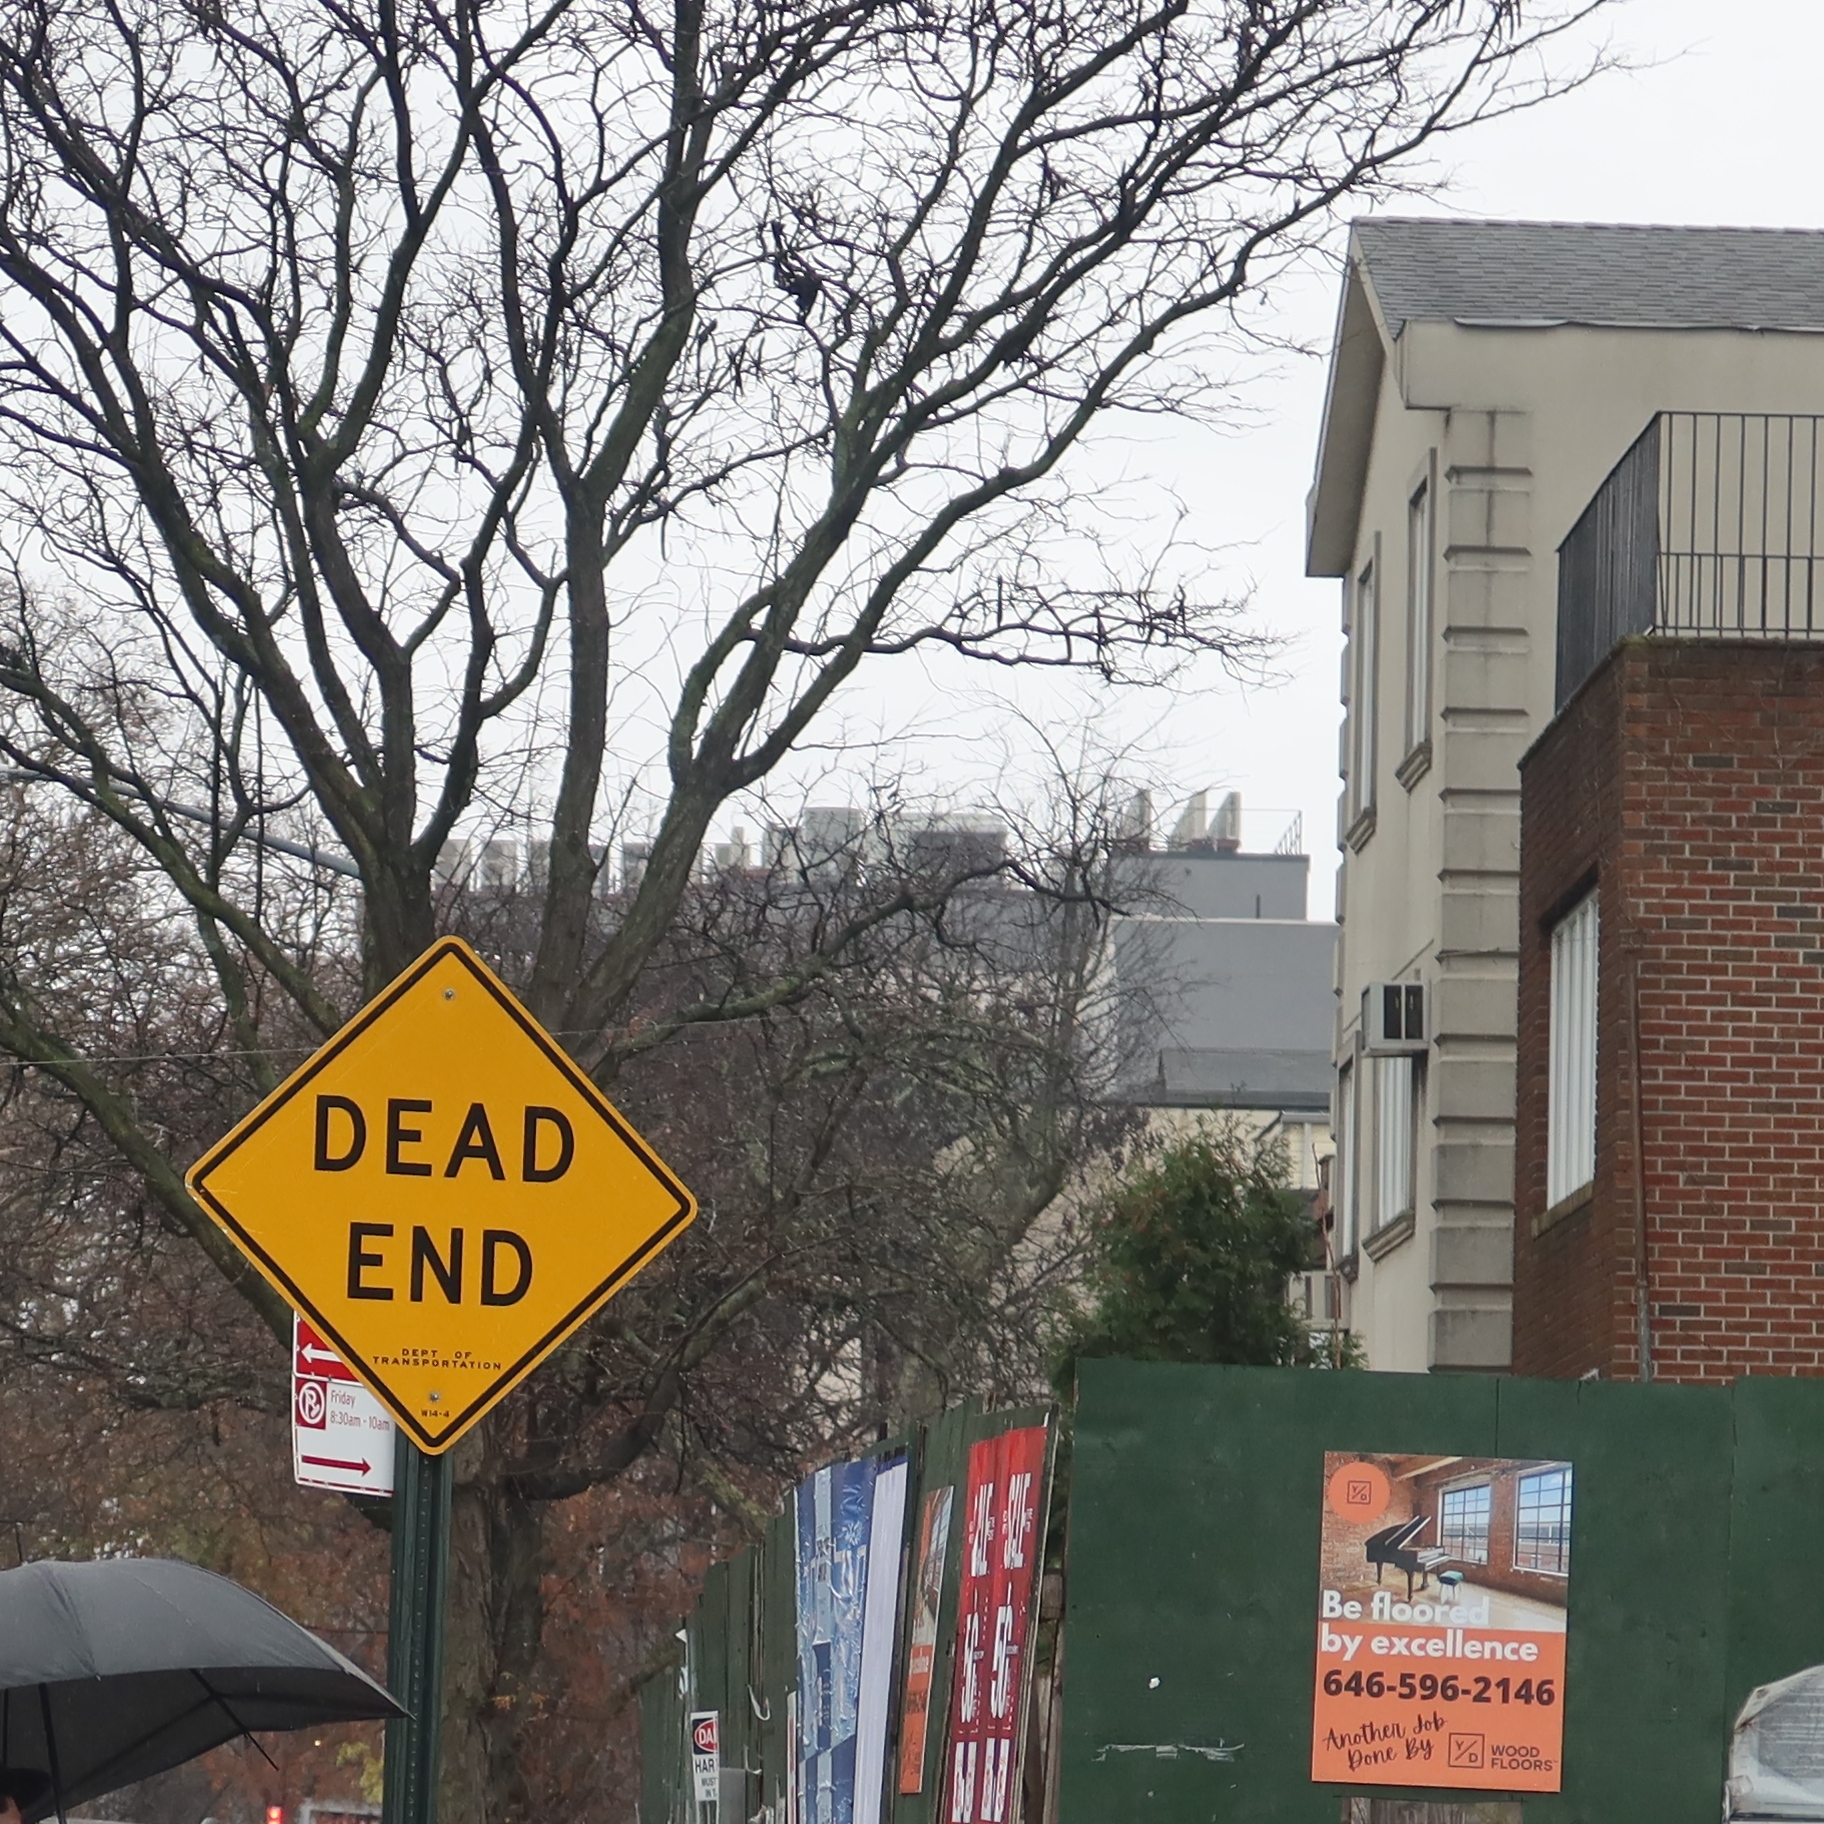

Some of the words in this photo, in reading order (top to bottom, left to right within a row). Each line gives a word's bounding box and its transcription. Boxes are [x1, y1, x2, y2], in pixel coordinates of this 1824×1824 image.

[313, 1094, 575, 1183] DEAD
[347, 1221, 533, 1307] END
[372, 1356, 502, 1371] TRANSPORTATION
[401, 1348, 439, 1358] DEPT
[454, 1351, 473, 1360] OF
[330, 1389, 356, 1409] Friday
[330, 1411, 362, 1429] 8:30am
[368, 1416, 391, 1431] 10am
[420, 1409, 450, 1418] W14-4
[1322, 1590, 1363, 1620] Be
[1370, 1591, 1490, 1626] floored
[1321, 1623, 1364, 1662] by
[1370, 1629, 1539, 1662] excellence
[1323, 1669, 1556, 1706] 646-596-2146
[1322, 1717, 1407, 1752] Another
[1413, 1711, 1448, 1735] Job
[1347, 1745, 1398, 1772] Done
[1405, 1735, 1435, 1761] By
[1490, 1744, 1541, 1758] WOOD
[695, 1758, 717, 1774] HAR
[1490, 1758, 1554, 1772] FLOORS
